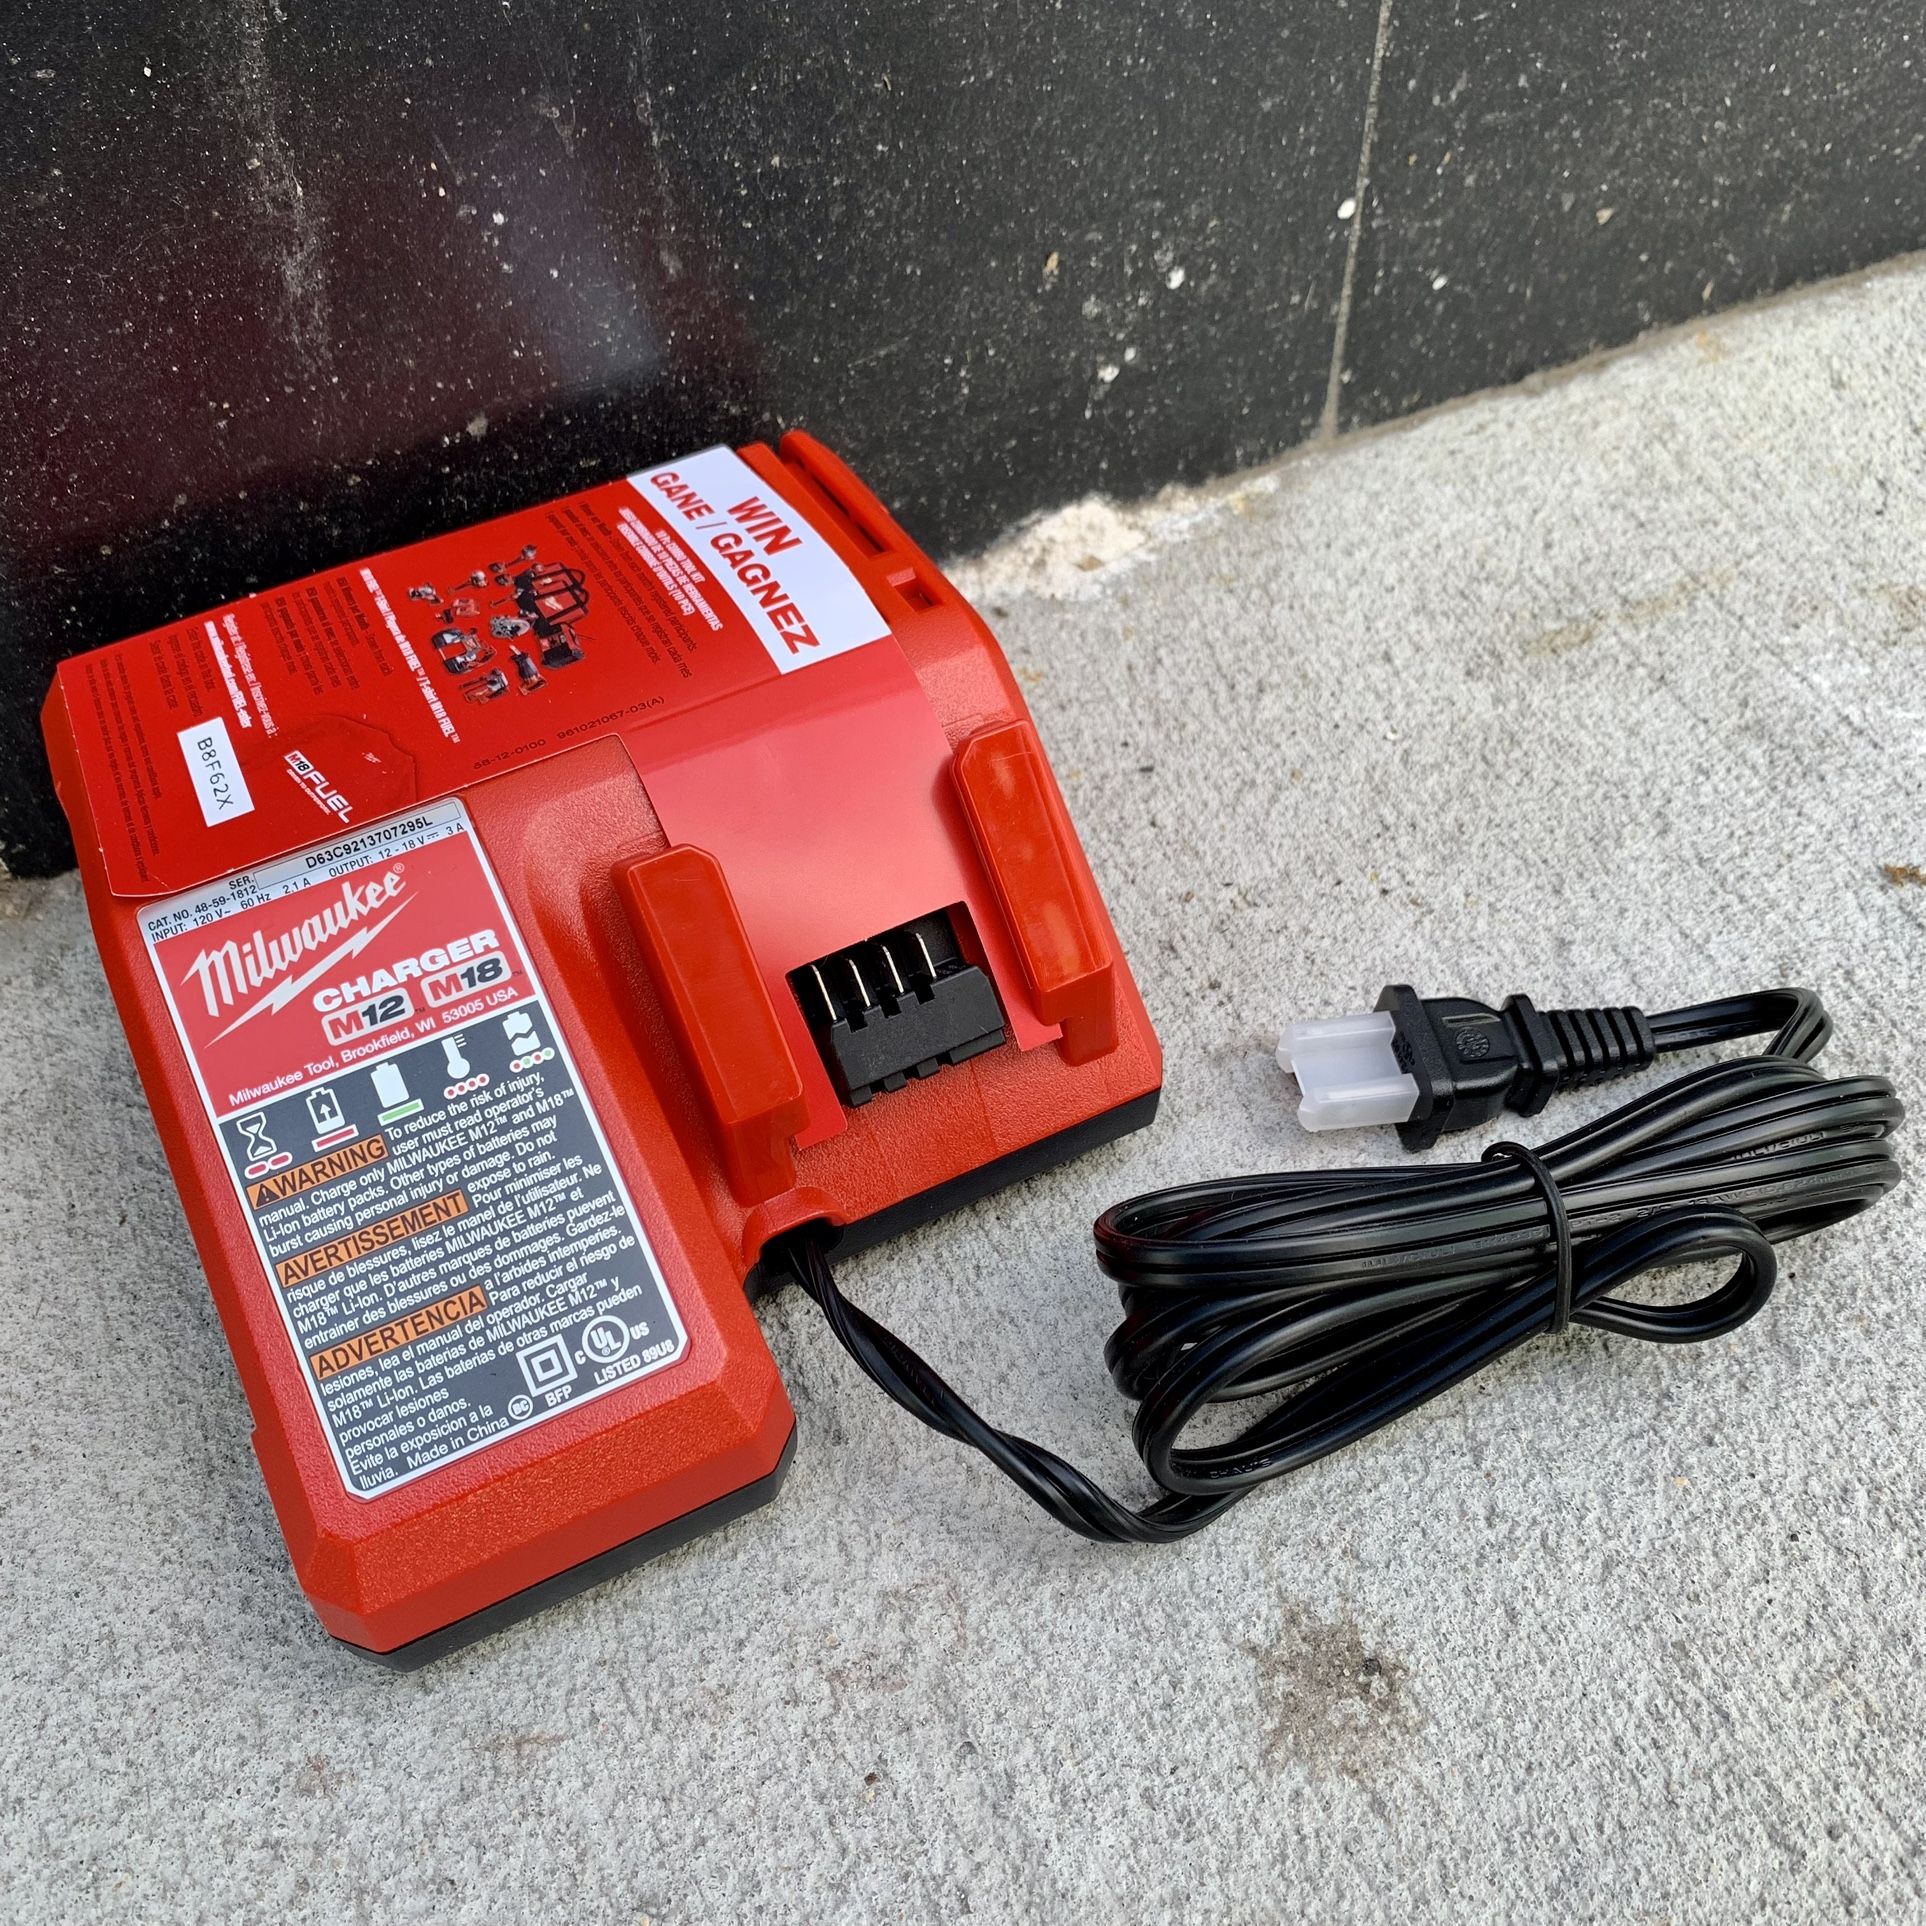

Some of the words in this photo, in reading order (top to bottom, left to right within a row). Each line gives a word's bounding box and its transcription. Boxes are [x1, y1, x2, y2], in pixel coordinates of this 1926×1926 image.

[650, 471, 715, 521] GANE
[710, 532, 821, 655] GAGNEZ
[726, 496, 803, 556] WIN
[197, 736, 234, 810] B8F62X
[286, 752, 312, 773] M18
[302, 770, 353, 824] FUEL
[304, 815, 433, 869] D63C9213707295L
[147, 915, 172, 931] CAT.
[172, 908, 193, 922] NO.
[194, 884, 257, 913] 48-59-1812
[150, 921, 188, 942] INPUT:
[192, 911, 214, 927] 120
[239, 896, 255, 910] 60
[255, 892, 271, 904] Hz
[328, 854, 373, 877] OUTPUT:
[377, 847, 392, 859] 12
[401, 838, 416, 851] 18
[228, 874, 254, 890] SER.
[181, 871, 406, 1017] Milwaukee
[312, 928, 500, 1012] CHARGER
[327, 994, 406, 1040] M12
[427, 957, 503, 1001] M18
[228, 1070, 303, 1106] Milwaukee
[303, 1055, 339, 1076] Tool,
[340, 1026, 415, 1063] Brookfield,
[414, 1016, 436, 1033] WI
[441, 997, 484, 1023] 53005
[484, 986, 519, 1006] USA
[383, 1126, 403, 1141] To
[403, 1109, 447, 1134] reduce
[446, 1100, 469, 1116] the
[469, 1089, 493, 1108] risk
[493, 1081, 507, 1098] of
[506, 1071, 545, 1093] injury,
[391, 1136, 419, 1156] user
[421, 1121, 454, 1144] must
[453, 1108, 483, 1131] read
[258, 1196, 310, 1228] manual.
[310, 1179, 358, 1205] Charge
[358, 1167, 385, 1186] only
[385, 1131, 469, 1175] MILWAUKEE
[510, 1103, 536, 1124] and
[262, 1219, 301, 1243] Li-Ion
[300, 1200, 345, 1227] battery
[346, 1185, 389, 1211] packs.
[389, 1167, 425, 1190] Other
[426, 1153, 462, 1177] types
[462, 1144, 476, 1161] of
[475, 1125, 530, 1155] batteries
[530, 1114, 557, 1133] may
[268, 1233, 304, 1258] burst
[303, 1214, 354, 1243] causing
[354, 1189, 409, 1226] personal
[408, 1177, 443, 1200] injury
[445, 1170, 459, 1185] or
[460, 1150, 515, 1178] damage.
[514, 1140, 535, 1156] Do
[535, 1129, 558, 1148] not
[272, 1137, 386, 1199] WARNING
[466, 1167, 512, 1193] expose
[511, 1161, 526, 1174] to
[526, 1150, 556, 1168] rain.
[471, 1186, 502, 1208] Pour
[503, 1162, 562, 1195] minimiser
[561, 1154, 583, 1170] les
[283, 1191, 461, 1285] AVERTISSEMENT
[286, 1278, 326, 1303] risque
[327, 1270, 345, 1286] de
[345, 1244, 412, 1278] blessures,
[410, 1230, 443, 1251] lisez
[441, 1224, 456, 1238] le
[456, 1204, 496, 1232] manel
[496, 1200, 514, 1215] de
[581, 1163, 602, 1179] Ne
[292, 1289, 340, 1318] charger
[342, 1279, 368, 1298] que
[367, 1270, 389, 1286] les
[388, 1246, 445, 1277] batteries
[444, 1208, 527, 1254] MILWAUKEE
[569, 1185, 584, 1201] et
[341, 1291, 383, 1316] Li-Ion.
[437, 1243, 493, 1275] marques
[493, 1235, 511, 1251] de
[510, 1212, 566, 1243] batteries
[565, 1189, 616, 1224] puevent
[488, 1284, 521, 1306] Para
[520, 1264, 563, 1292] reducir
[565, 1256, 579, 1272] el
[578, 1242, 617, 1267] riesgo
[618, 1234, 635, 1250] de
[547, 1224, 622, 1263] intemperies.
[303, 1316, 359, 1349] entrainer
[361, 1306, 386, 1325] des
[386, 1280, 448, 1314] blessures
[449, 1272, 467, 1287] ou
[468, 1261, 492, 1279] des
[493, 1232, 565, 1268] dommages.
[565, 1204, 625, 1237] Gardez-le
[318, 1290, 486, 1378] ADVERTENCIA
[319, 1365, 379, 1396] lesiones,
[377, 1354, 401, 1371] lea
[401, 1344, 415, 1361] el
[415, 1323, 463, 1356] manual
[464, 1314, 485, 1334] del
[485, 1291, 545, 1325] operador.
[545, 1271, 588, 1298] Cargar
[326, 1375, 393, 1412] solamente
[392, 1365, 415, 1383] las
[414, 1343, 467, 1374] baterias
[467, 1335, 485, 1350] de
[485, 1295, 568, 1343] MILWAUKEE
[375, 1384, 418, 1408] Li-Ion.
[417, 1371, 444, 1390] Las
[443, 1348, 496, 1379] baterias
[497, 1340, 514, 1356] de
[515, 1325, 548, 1347] otras
[548, 1305, 595, 1333] marcas
[595, 1284, 643, 1316] pueden
[593, 1353, 641, 1385] LISTED
[338, 1410, 394, 1447] provocar
[394, 1387, 449, 1419] lesiones
[344, 1420, 415, 1463] personales
[427, 1397, 471, 1423] danos.
[544, 1384, 572, 1407] BFP
[349, 1452, 384, 1476] Evite
[383, 1445, 399, 1460] la
[399, 1415, 467, 1453] exposicion
[477, 1404, 493, 1418] la
[358, 1466, 398, 1494] lluvia.
[405, 1443, 449, 1469] Made
[449, 1435, 465, 1450] in
[466, 1416, 510, 1441] China
